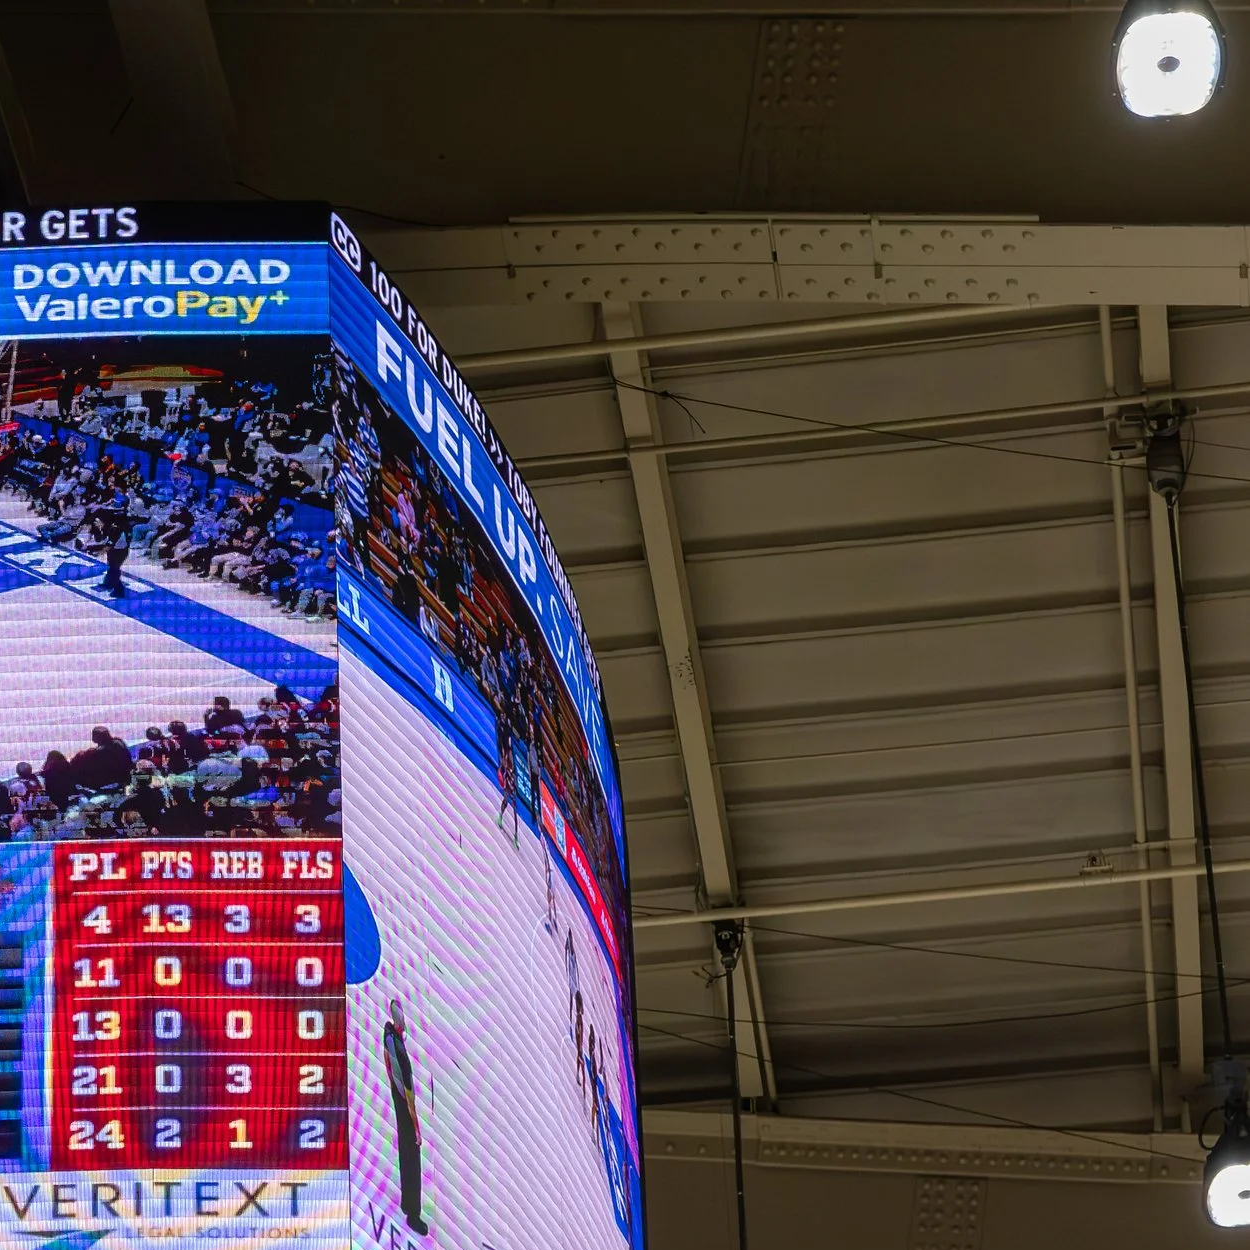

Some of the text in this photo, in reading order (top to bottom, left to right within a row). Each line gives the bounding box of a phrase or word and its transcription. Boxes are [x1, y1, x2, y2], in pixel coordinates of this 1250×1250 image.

[40, 207, 139, 239] GETS
[13, 259, 290, 289] DOWNLOAD
[369, 262, 401, 321] 100
[408, 308, 437, 371] FOR
[442, 356, 487, 440] DUKE!
[506, 454, 537, 531] TOBY
[377, 319, 484, 514] FUEL
[493, 483, 543, 616] UP.
[69, 851, 334, 881] PL PTS REB FLS
[82, 904, 321, 934] 4 13 3 3
[72, 957, 323, 987] 11 0 0 0
[71, 1009, 324, 1041] 13 0 0 0
[72, 1065, 324, 1094] 21 0 3 2
[69, 1118, 325, 1150] 24 2 1 2
[3, 1181, 309, 1222] VERITEXT
